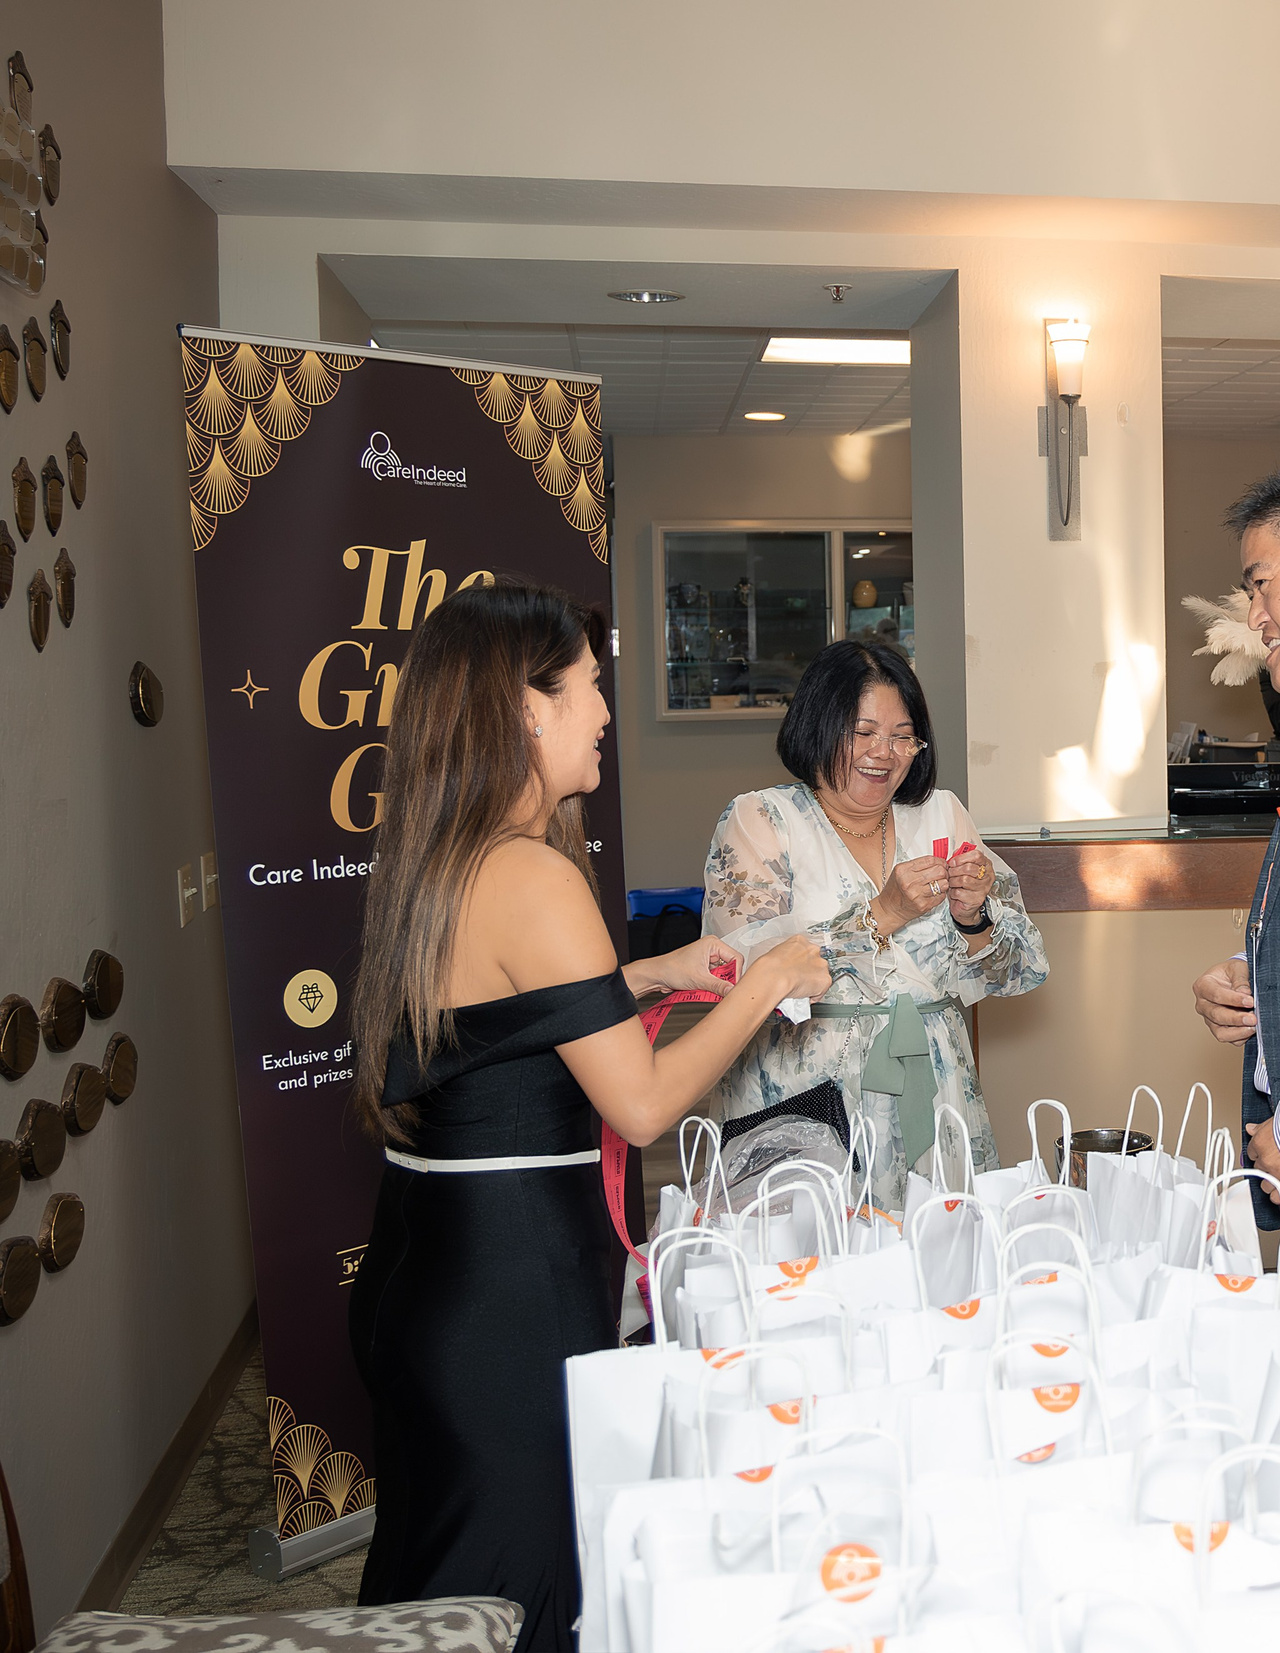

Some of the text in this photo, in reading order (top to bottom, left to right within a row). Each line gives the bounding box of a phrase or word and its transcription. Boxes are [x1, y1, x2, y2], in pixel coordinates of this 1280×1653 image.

[376, 461, 467, 482] CareIndeed
[248, 863, 304, 886] Care
[262, 1040, 353, 1071] Exclusive gif
[278, 1068, 354, 1091] and prizes
